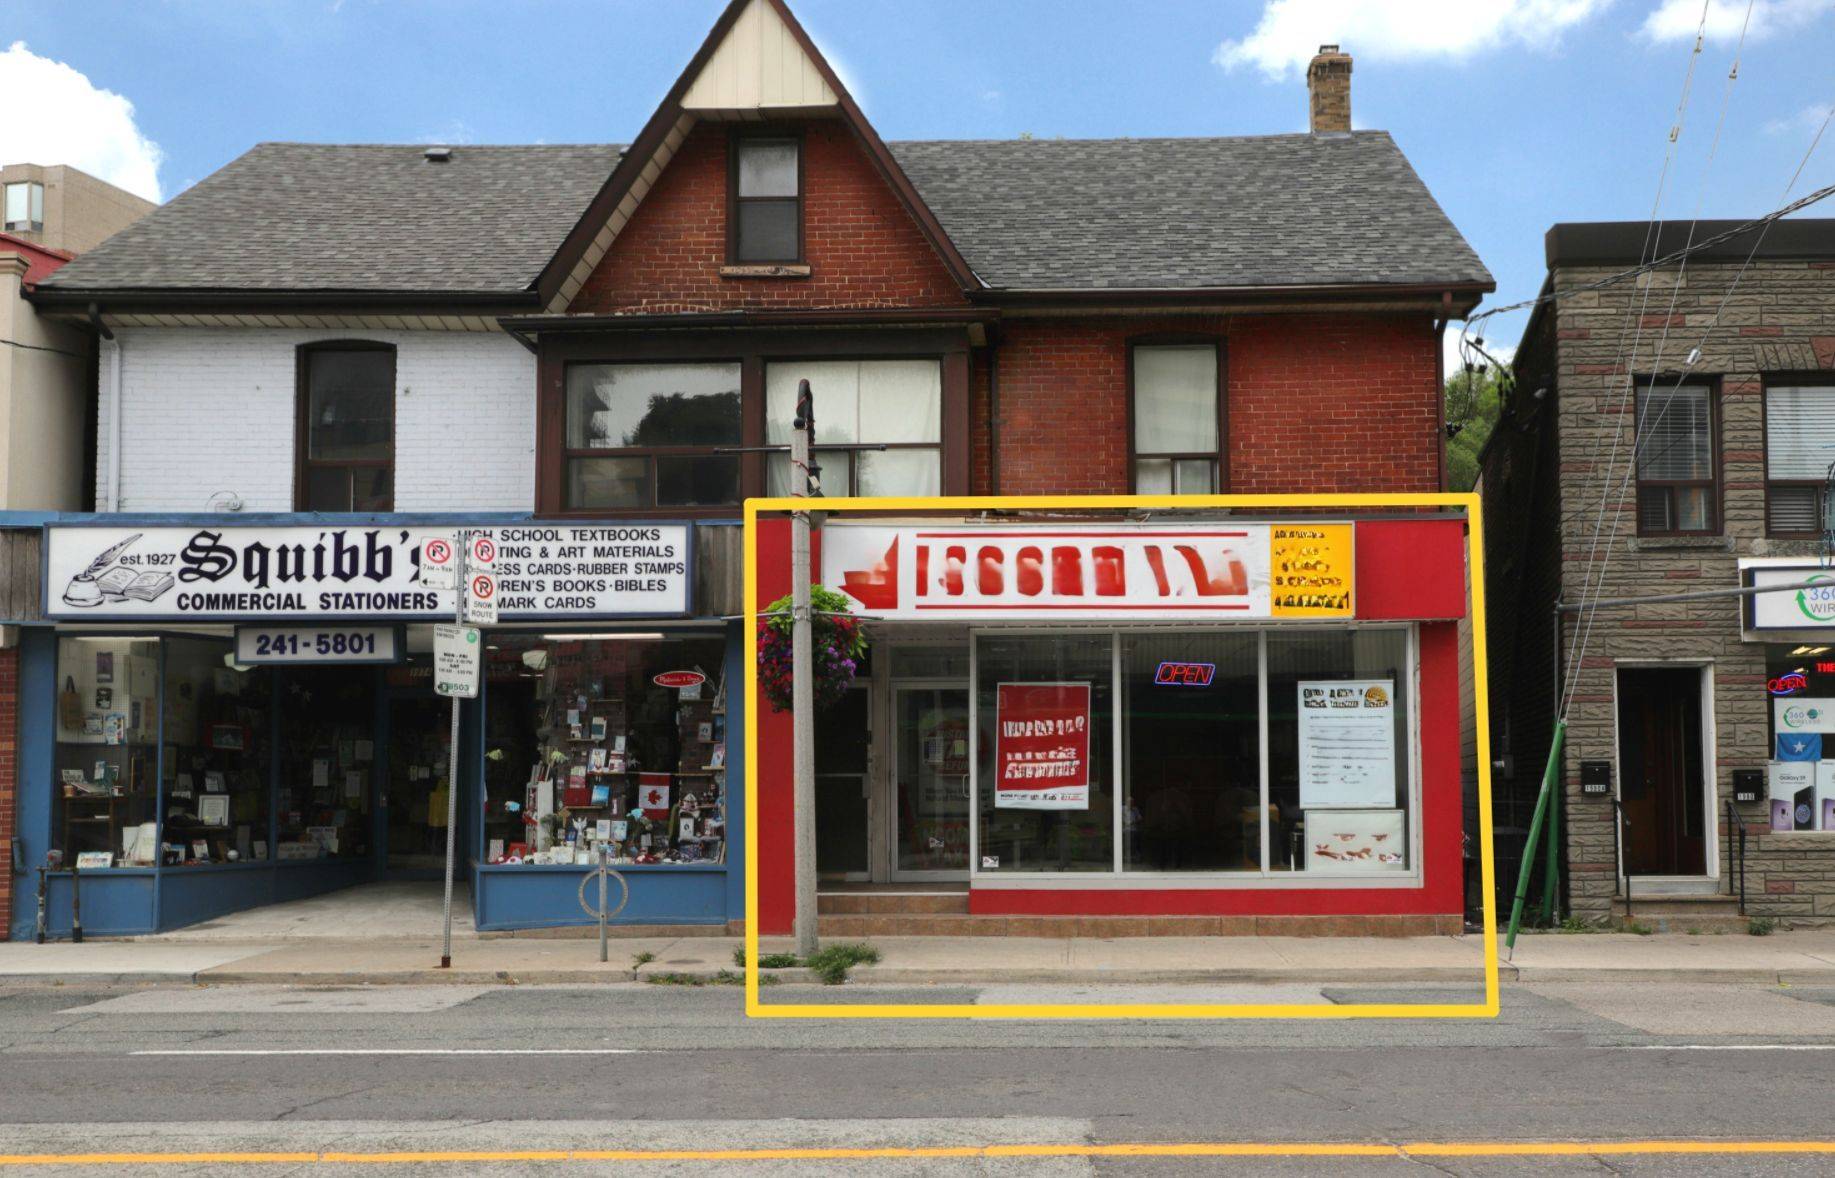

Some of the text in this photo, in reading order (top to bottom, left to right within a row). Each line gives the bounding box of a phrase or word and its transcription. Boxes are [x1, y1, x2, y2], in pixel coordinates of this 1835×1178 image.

[500, 529, 563, 541] SCHOOL
[571, 529, 661, 541] TEXTBOOKS
[539, 546, 549, 558] &
[557, 546, 586, 558] ART
[593, 546, 675, 558] MATERIALS
[120, 553, 177, 565] est. 1927
[527, 563, 572, 575] CARDS
[577, 563, 629, 575] RUBBER
[634, 562, 685, 575] STAMPS
[553, 580, 606, 592] BOOKS
[614, 580, 667, 592] BIBLES
[177, 592, 439, 610] COMMERCIAL STATIONERS
[474, 601, 492, 609] SNOW
[544, 597, 596, 609] CARDS
[471, 610, 494, 619] ROUTE
[1159, 664, 1211, 683] OPEN
[1767, 676, 1807, 691] OPEN
